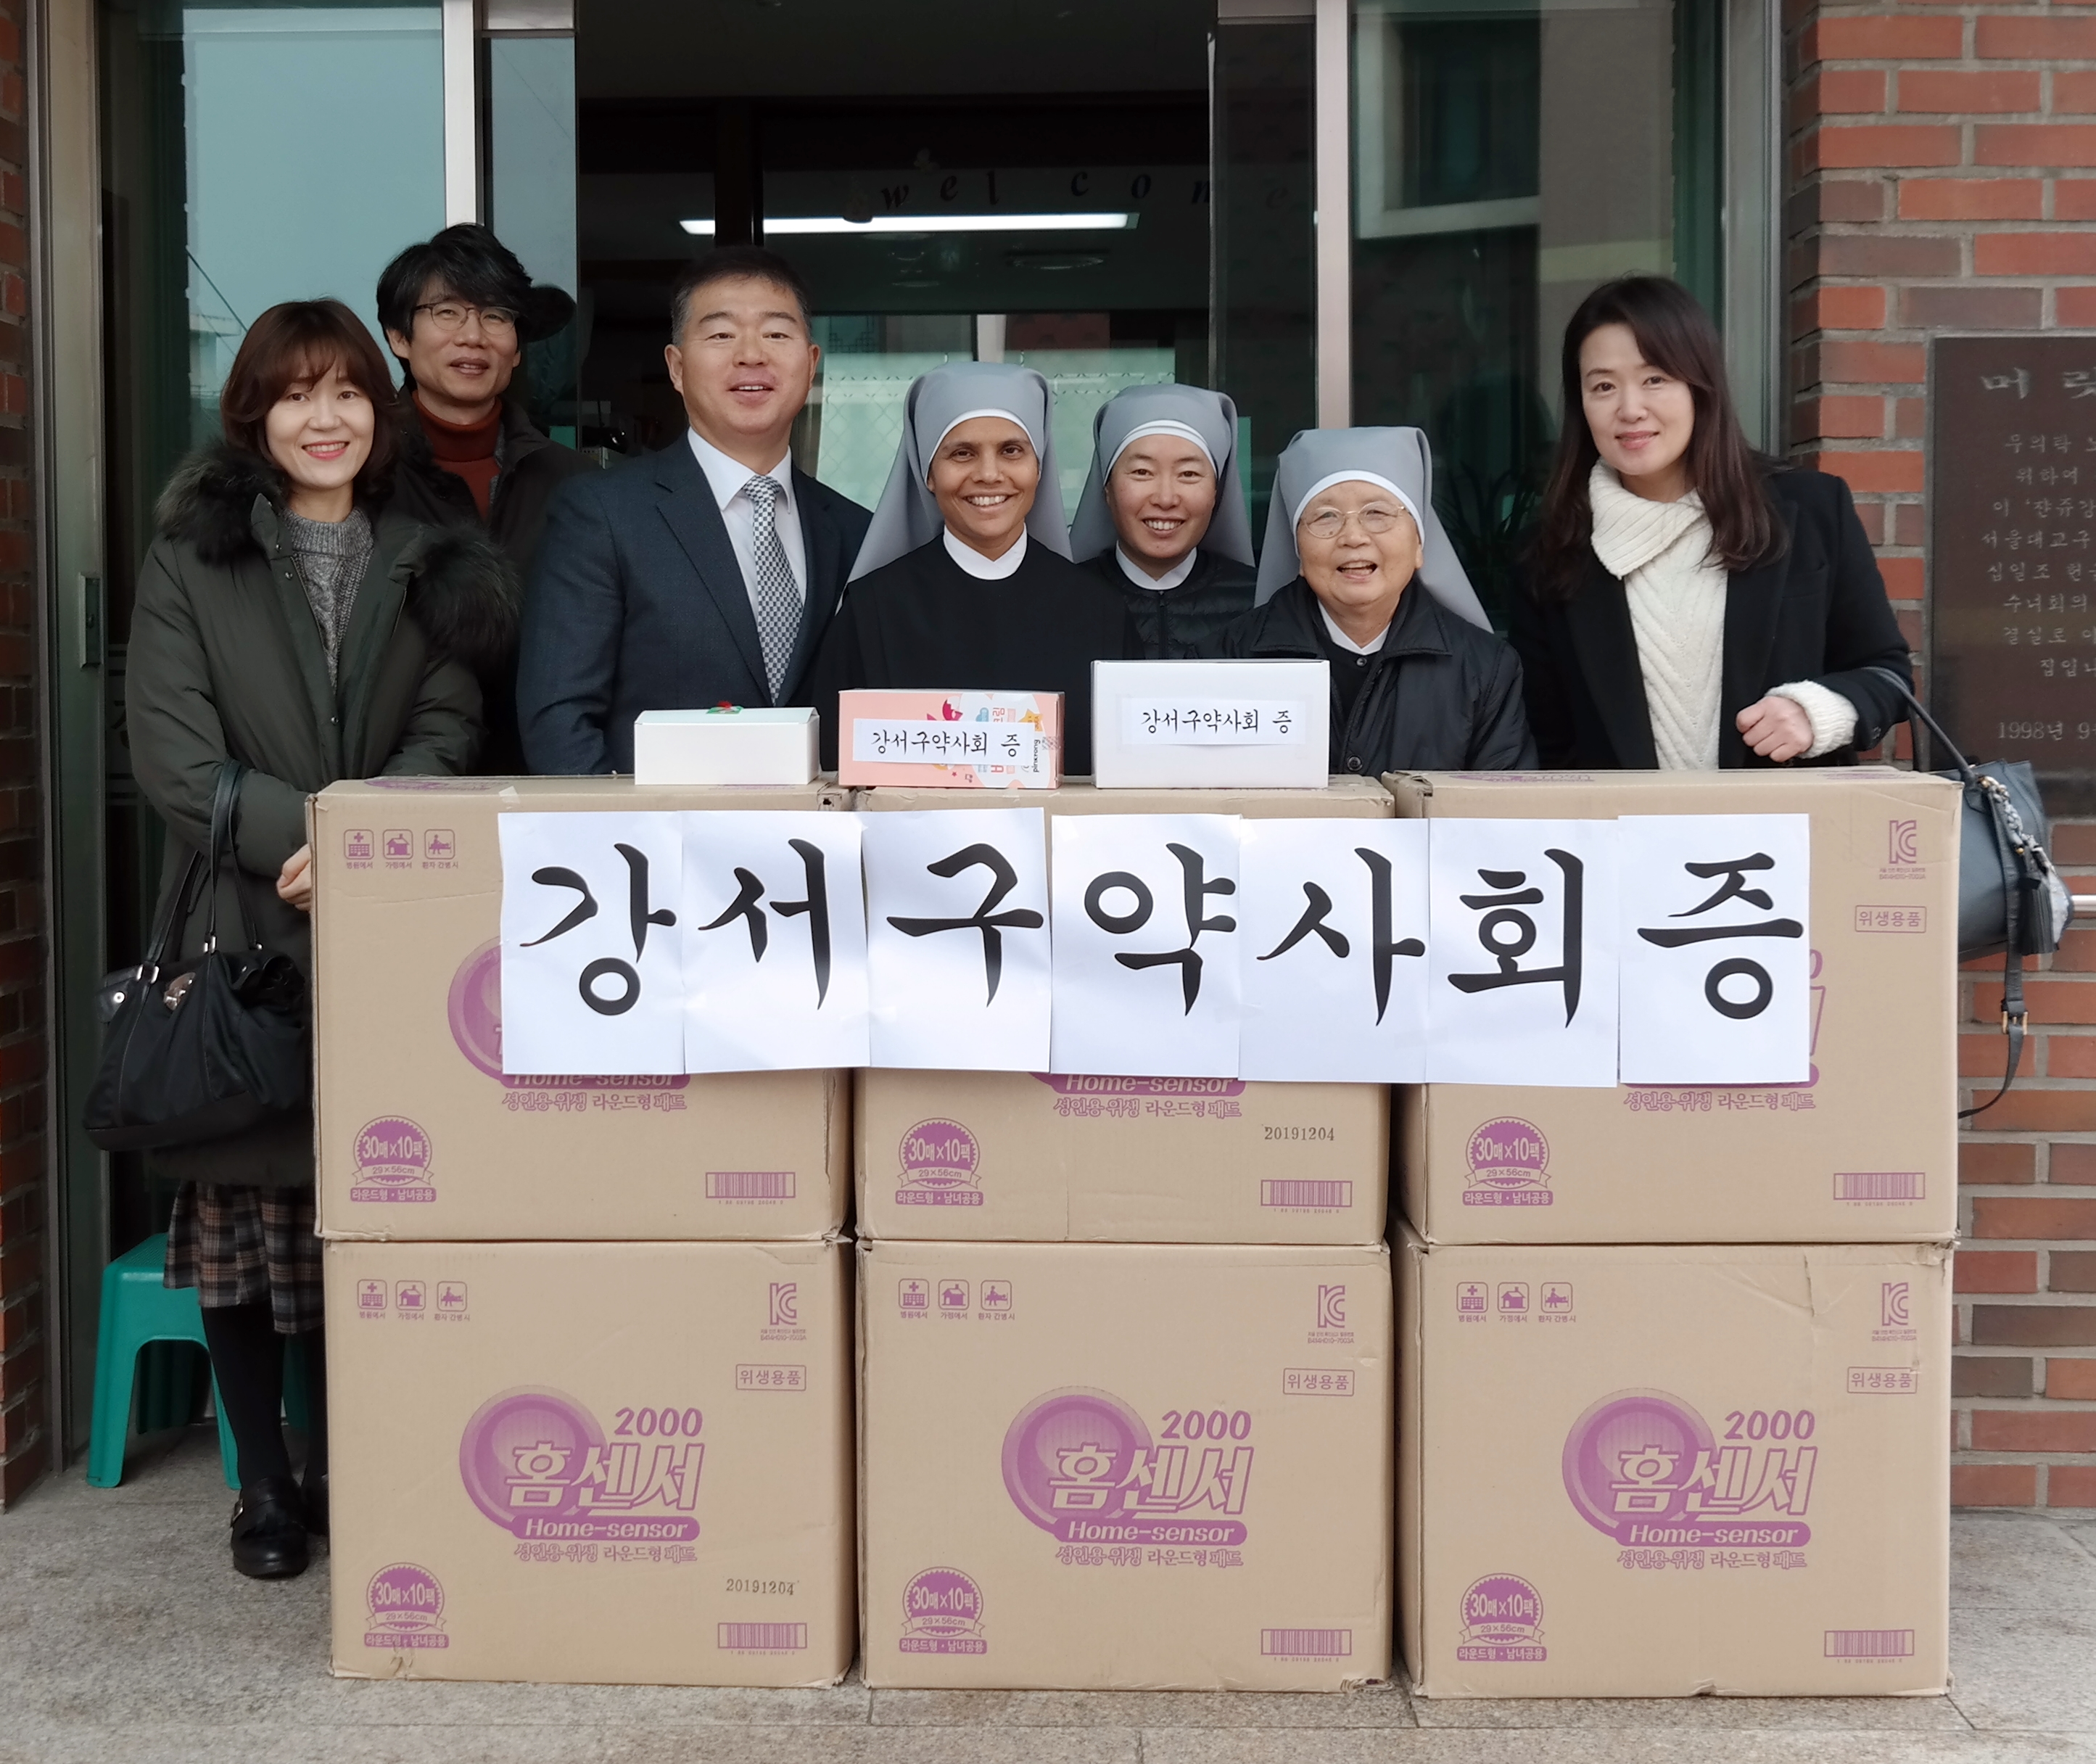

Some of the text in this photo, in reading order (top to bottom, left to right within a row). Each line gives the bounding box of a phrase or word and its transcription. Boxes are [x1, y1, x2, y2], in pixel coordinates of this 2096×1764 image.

[2016, 466, 2078, 485] 위하여
[1994, 498, 2009, 517] 이
[1981, 529, 2090, 550] 서울대교구
[1987, 561, 2050, 581] 십일조
[2003, 593, 2087, 612] 수녀회의
[2003, 626, 2066, 645] 결실로
[1141, 709, 1292, 734] 강서구약사회 증
[1998, 721, 2063, 741] 1998년
[871, 729, 1021, 757] 강서구약사회 증
[1859, 911, 1921, 927] 위생용품
[1065, 1073, 1233, 1093] Home-sensor
[593, 1093, 651, 1110] 라운드형
[654, 1092, 688, 1112] 패드
[1146, 1100, 1205, 1118] 라운드형
[1208, 1100, 1242, 1120] 패드
[1717, 1093, 1778, 1110] 라운드형
[1781, 1092, 1816, 1111] 패드
[1264, 1126, 1334, 1141] 20191204
[740, 1369, 801, 1385] 위생용품
[1287, 1374, 1349, 1390] 위생용품
[1852, 1372, 1912, 1388] 위생용품
[614, 1406, 703, 1437] 2000
[1160, 1410, 1252, 1441] 2000
[1723, 1409, 1815, 1441] 2000
[504, 1440, 706, 1511] 홈센서
[1047, 1442, 1255, 1515] 홈센서
[1609, 1444, 1818, 1515] 홈센서
[525, 1518, 689, 1538] Home-sensor
[1067, 1520, 1235, 1542] Home-sensor
[1629, 1524, 1799, 1544] Home-sensor
[603, 1545, 661, 1562] 라운드형
[664, 1545, 698, 1563] 패드
[1147, 1549, 1207, 1567] 라운드형
[1209, 1549, 1244, 1568] 패드
[1710, 1551, 1770, 1568] 라운드형
[1773, 1550, 1807, 1570] 패드
[726, 1578, 795, 1596] 20191204
